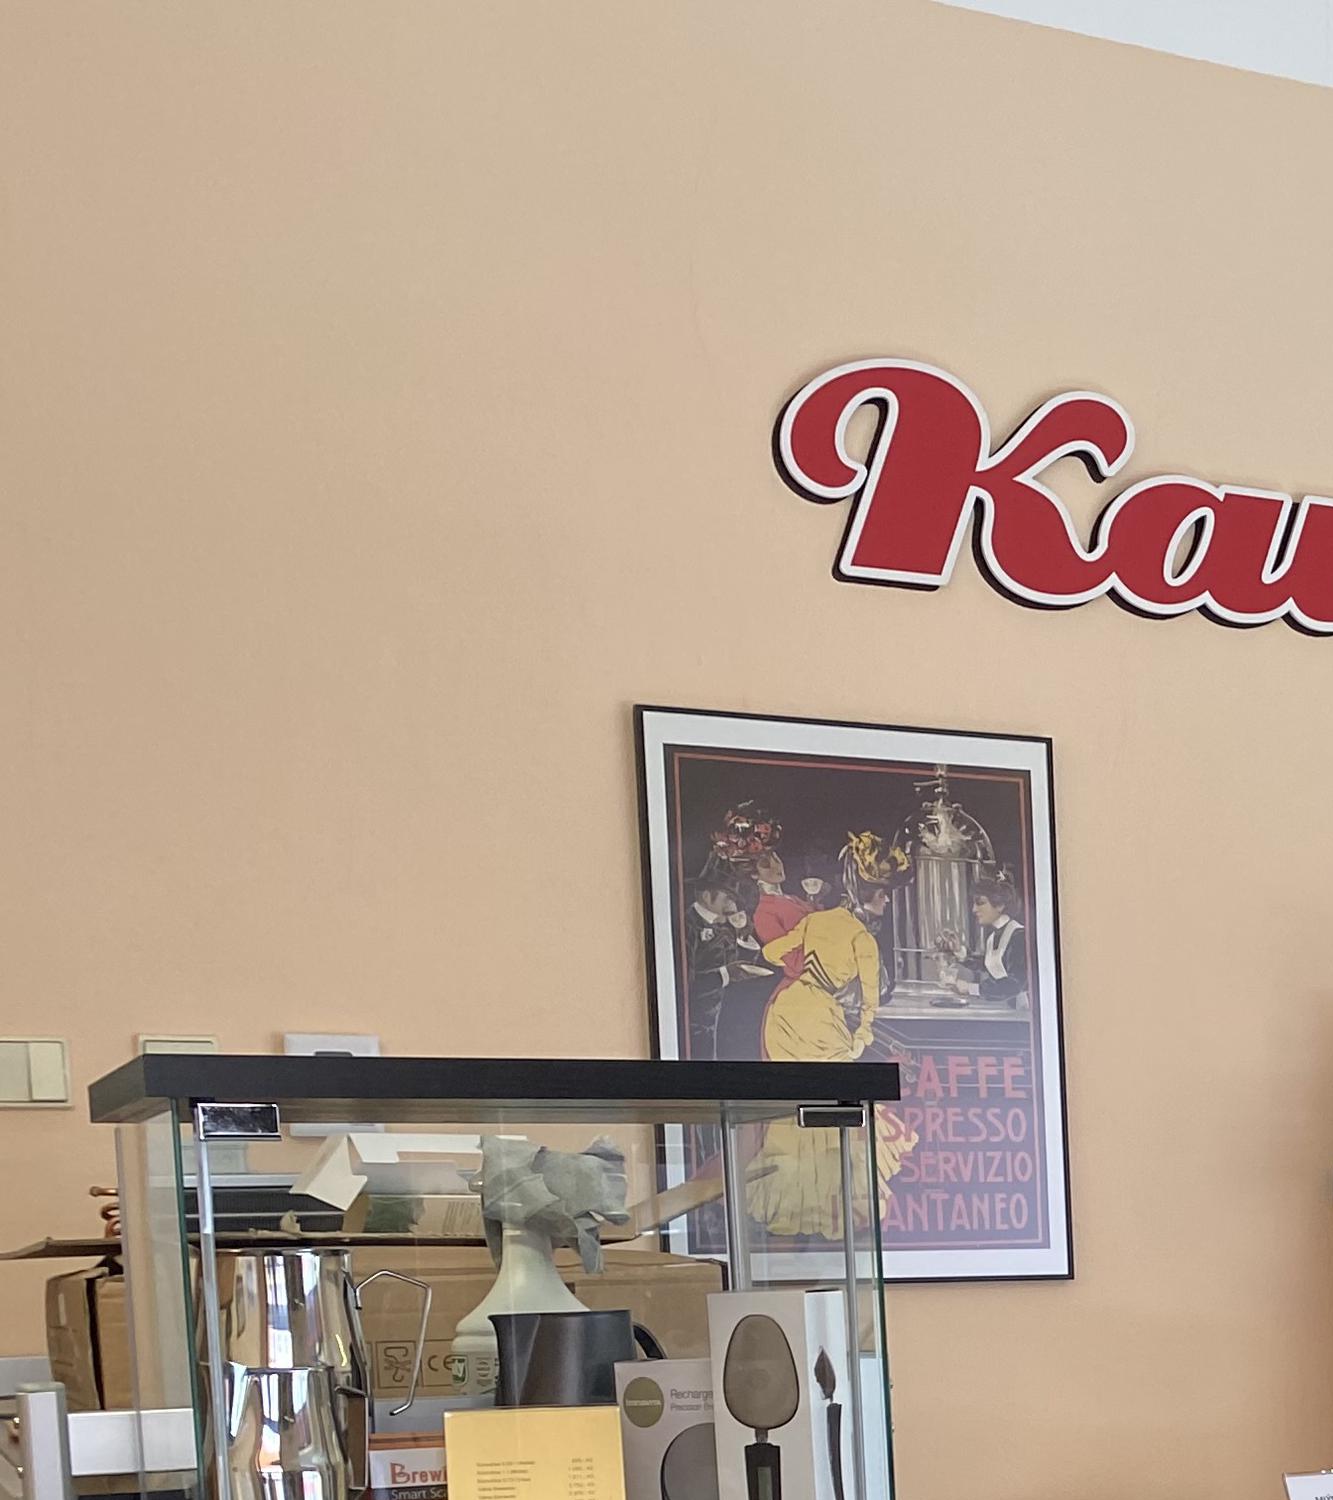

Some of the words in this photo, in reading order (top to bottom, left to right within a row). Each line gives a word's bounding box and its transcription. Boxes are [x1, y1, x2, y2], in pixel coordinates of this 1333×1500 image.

[899, 1150, 1033, 1184] SERVIZIO
[831, 1192, 1029, 1237] IANTANEO
[389, 1462, 447, 1485] Brew
[391, 1488, 426, 1500] Smart
